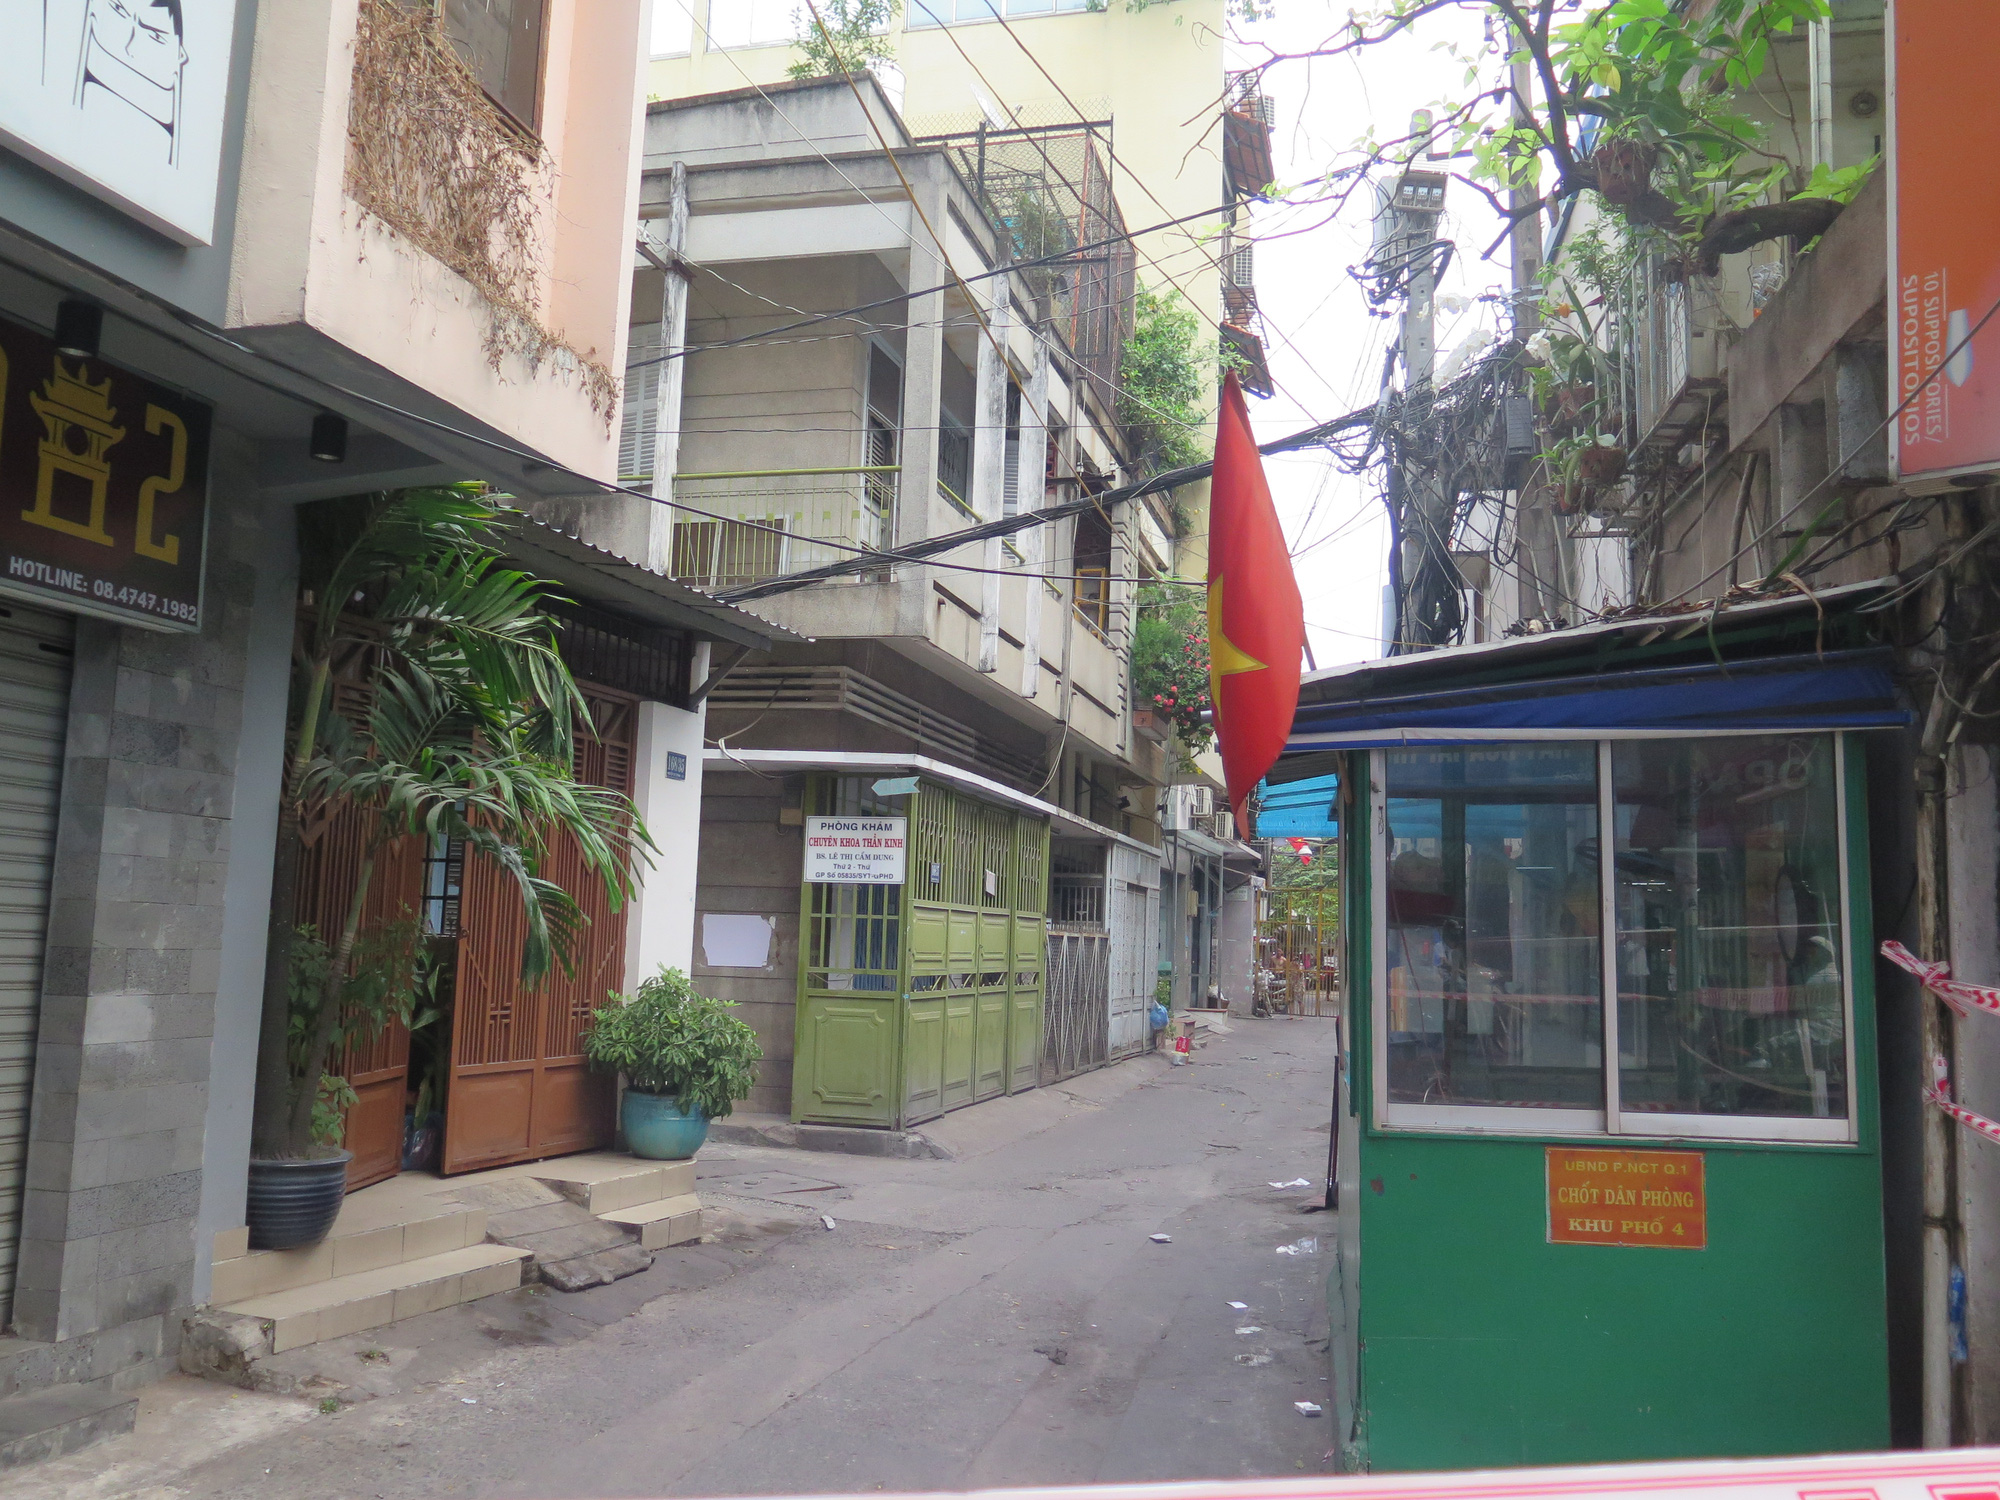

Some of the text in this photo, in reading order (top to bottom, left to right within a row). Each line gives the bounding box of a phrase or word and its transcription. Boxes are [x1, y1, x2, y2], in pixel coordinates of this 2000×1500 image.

[1924, 271, 1939, 292] 10
[9, 556, 197, 622] HOTLINE: 08.4747.1982
[820, 820, 893, 832] PHÒNG KHÁM
[808, 835, 838, 847] CHUYÊN
[840, 838, 860, 848] KHOA
[884, 838, 903, 848] KINH
[828, 851, 838, 860] LÊ
[1565, 1160, 1687, 1175] UBND P.NCT Q.1
[1558, 1181, 1694, 1208] CHỐT DÂN PHÒNG
[1568, 1216, 1685, 1236] KHU PHỐ 4
